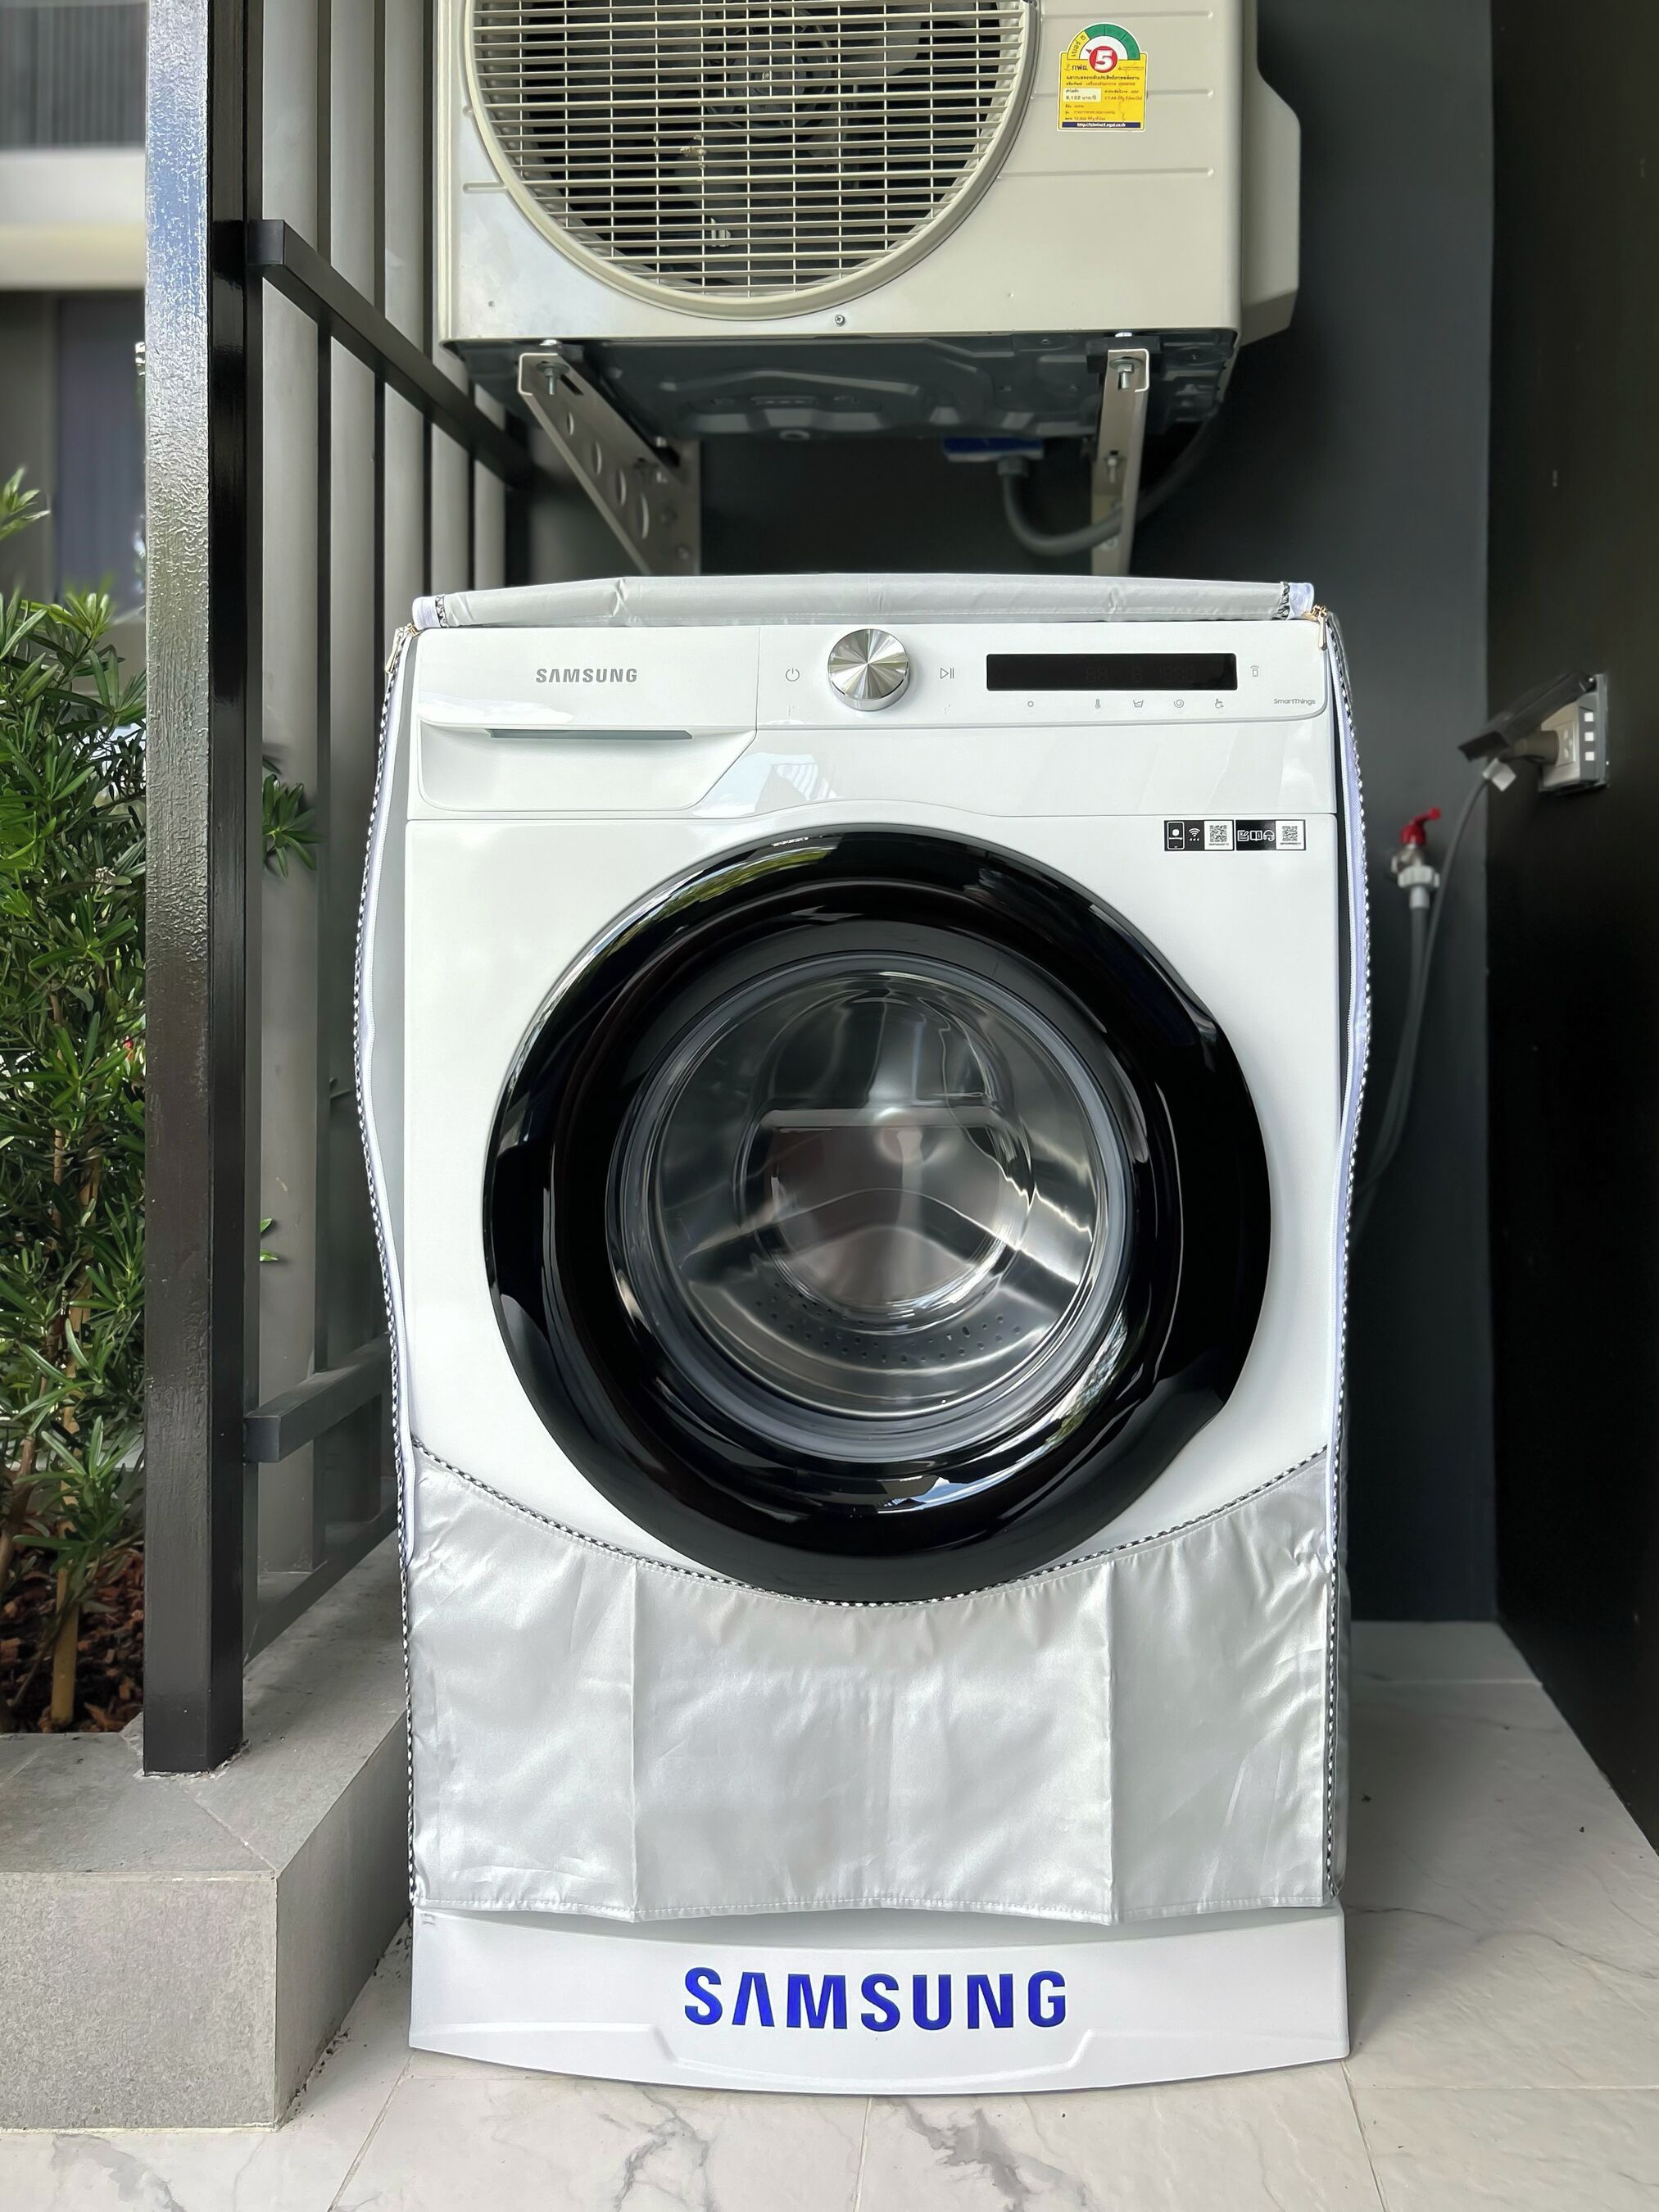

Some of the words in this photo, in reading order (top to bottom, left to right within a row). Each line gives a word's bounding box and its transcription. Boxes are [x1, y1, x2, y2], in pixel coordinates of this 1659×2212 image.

[1095, 50, 1113, 70] 5
[536, 669, 637, 682] SAMSUNG
[1273, 698, 1316, 706] SmartThings
[685, 1966, 1066, 2032] SAMSUNG
